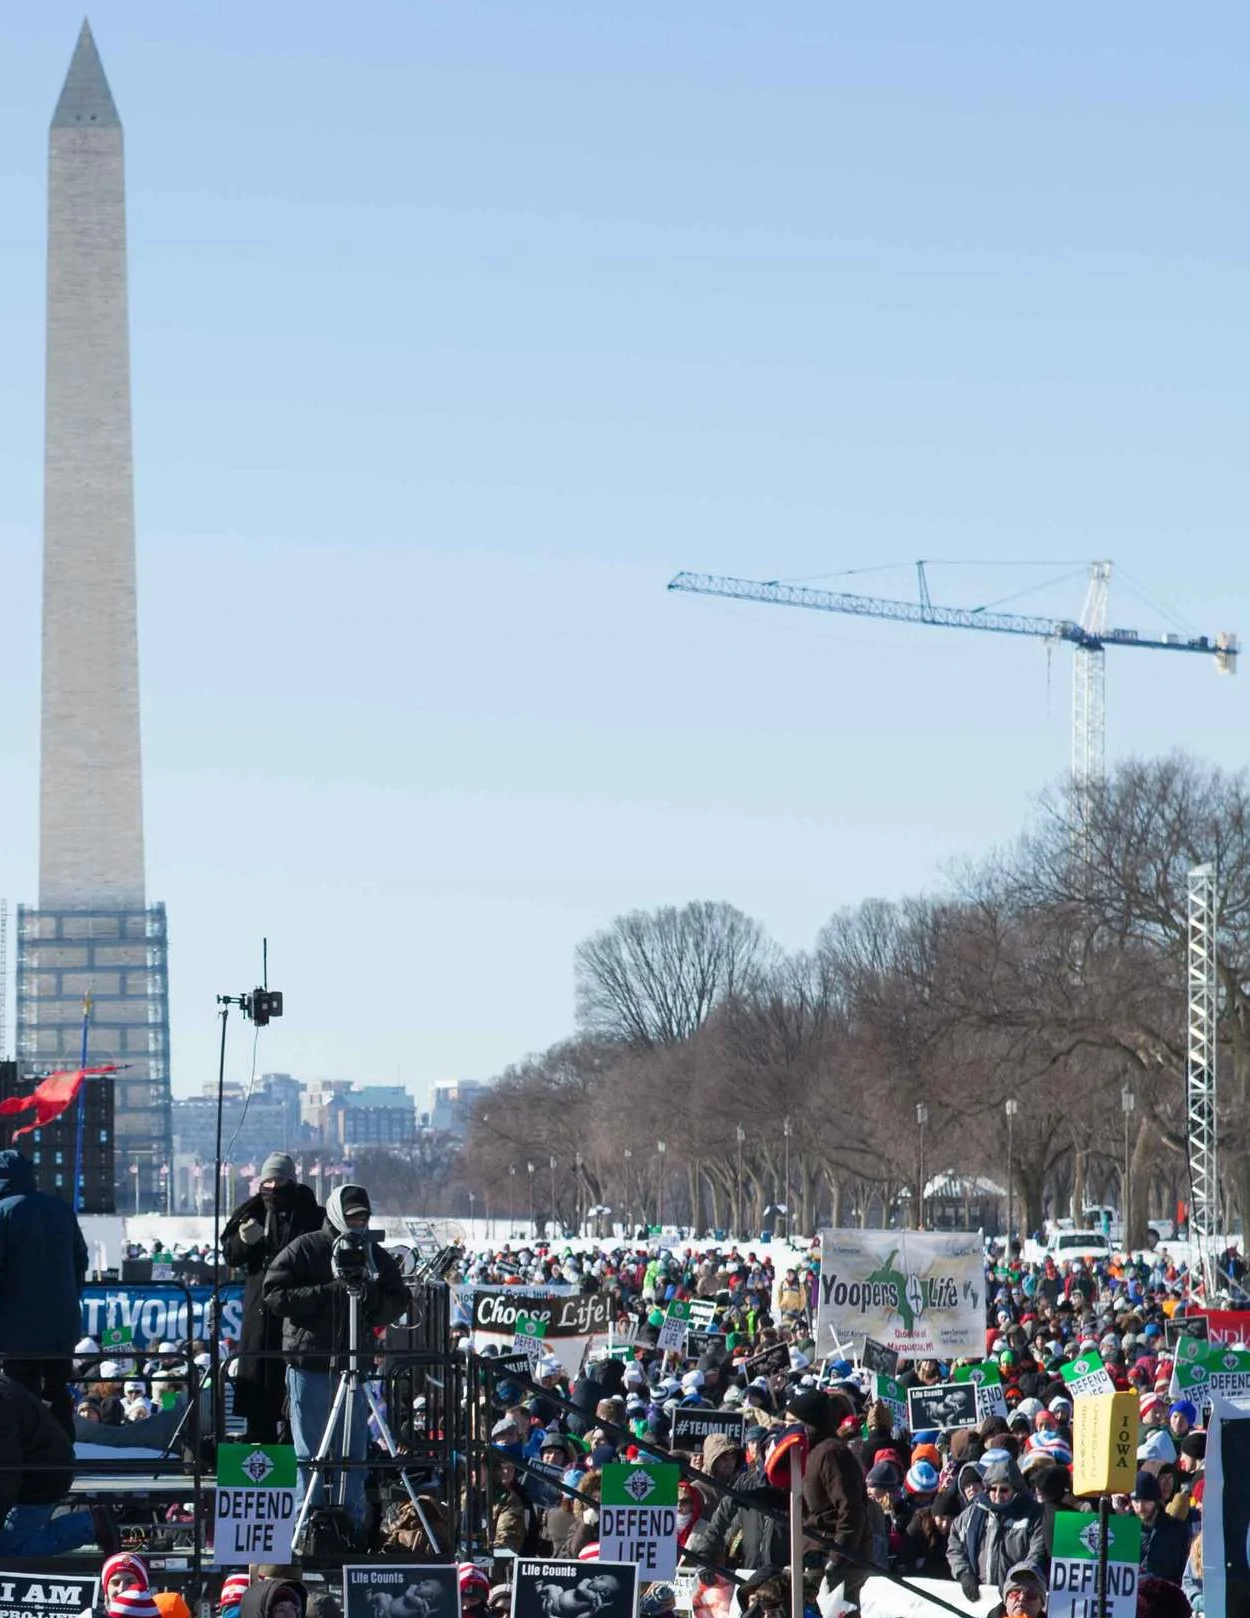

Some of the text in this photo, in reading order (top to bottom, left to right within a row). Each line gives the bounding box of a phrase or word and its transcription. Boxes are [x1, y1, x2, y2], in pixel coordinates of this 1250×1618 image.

[820, 1274, 898, 1313] Yoopers
[930, 1277, 959, 1309] Life
[558, 1297, 611, 1333] Life!
[1070, 1370, 1108, 1395] DEFEND
[676, 1420, 741, 1438] #TEAMLIFE
[1116, 1414, 1130, 1468] IOWA
[218, 1489, 293, 1520] DEFEND
[603, 1509, 676, 1538] DEFEND
[235, 1525, 273, 1552] LIFE
[351, 1571, 404, 1585] Life Counts
[522, 1563, 576, 1578] Life Counts
[0, 1583, 83, 1606] I AM
